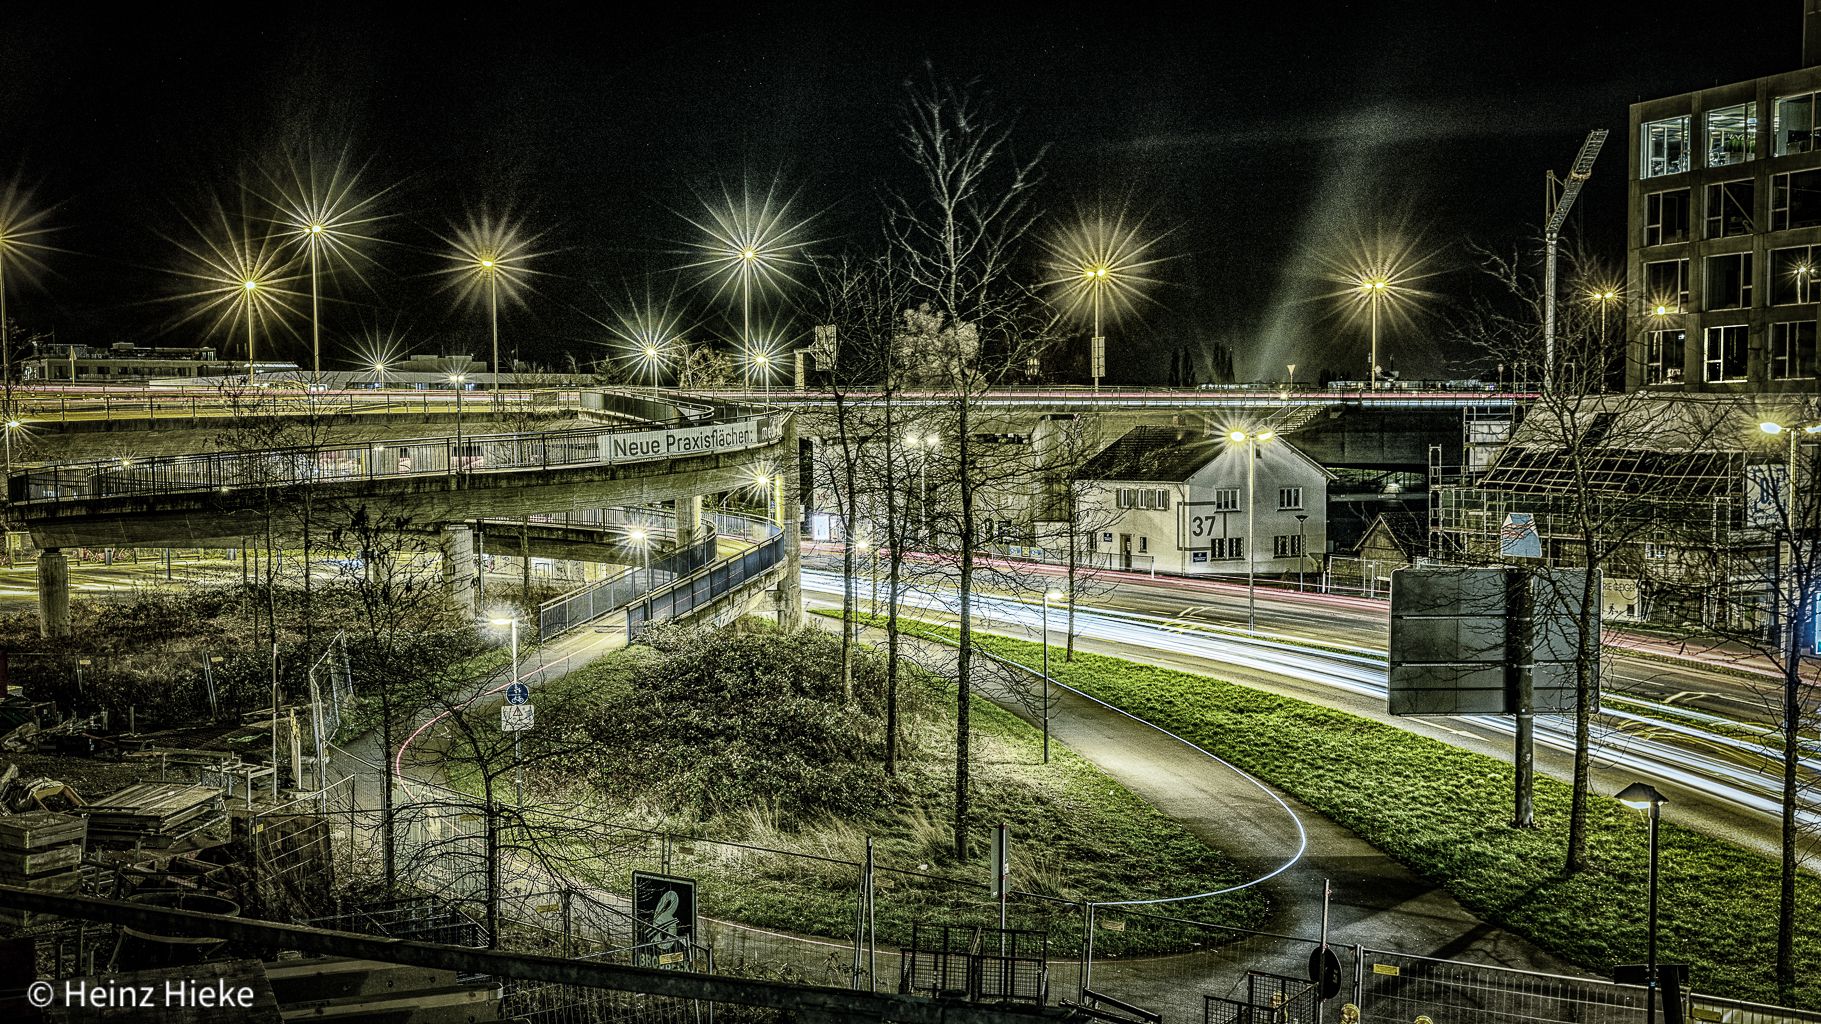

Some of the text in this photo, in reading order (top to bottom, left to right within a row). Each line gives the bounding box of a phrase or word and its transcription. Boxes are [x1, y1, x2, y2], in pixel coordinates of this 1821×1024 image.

[614, 438, 661, 457] Neue
[666, 427, 753, 453] Praxisflächen:
[1192, 515, 1216, 537] 37
